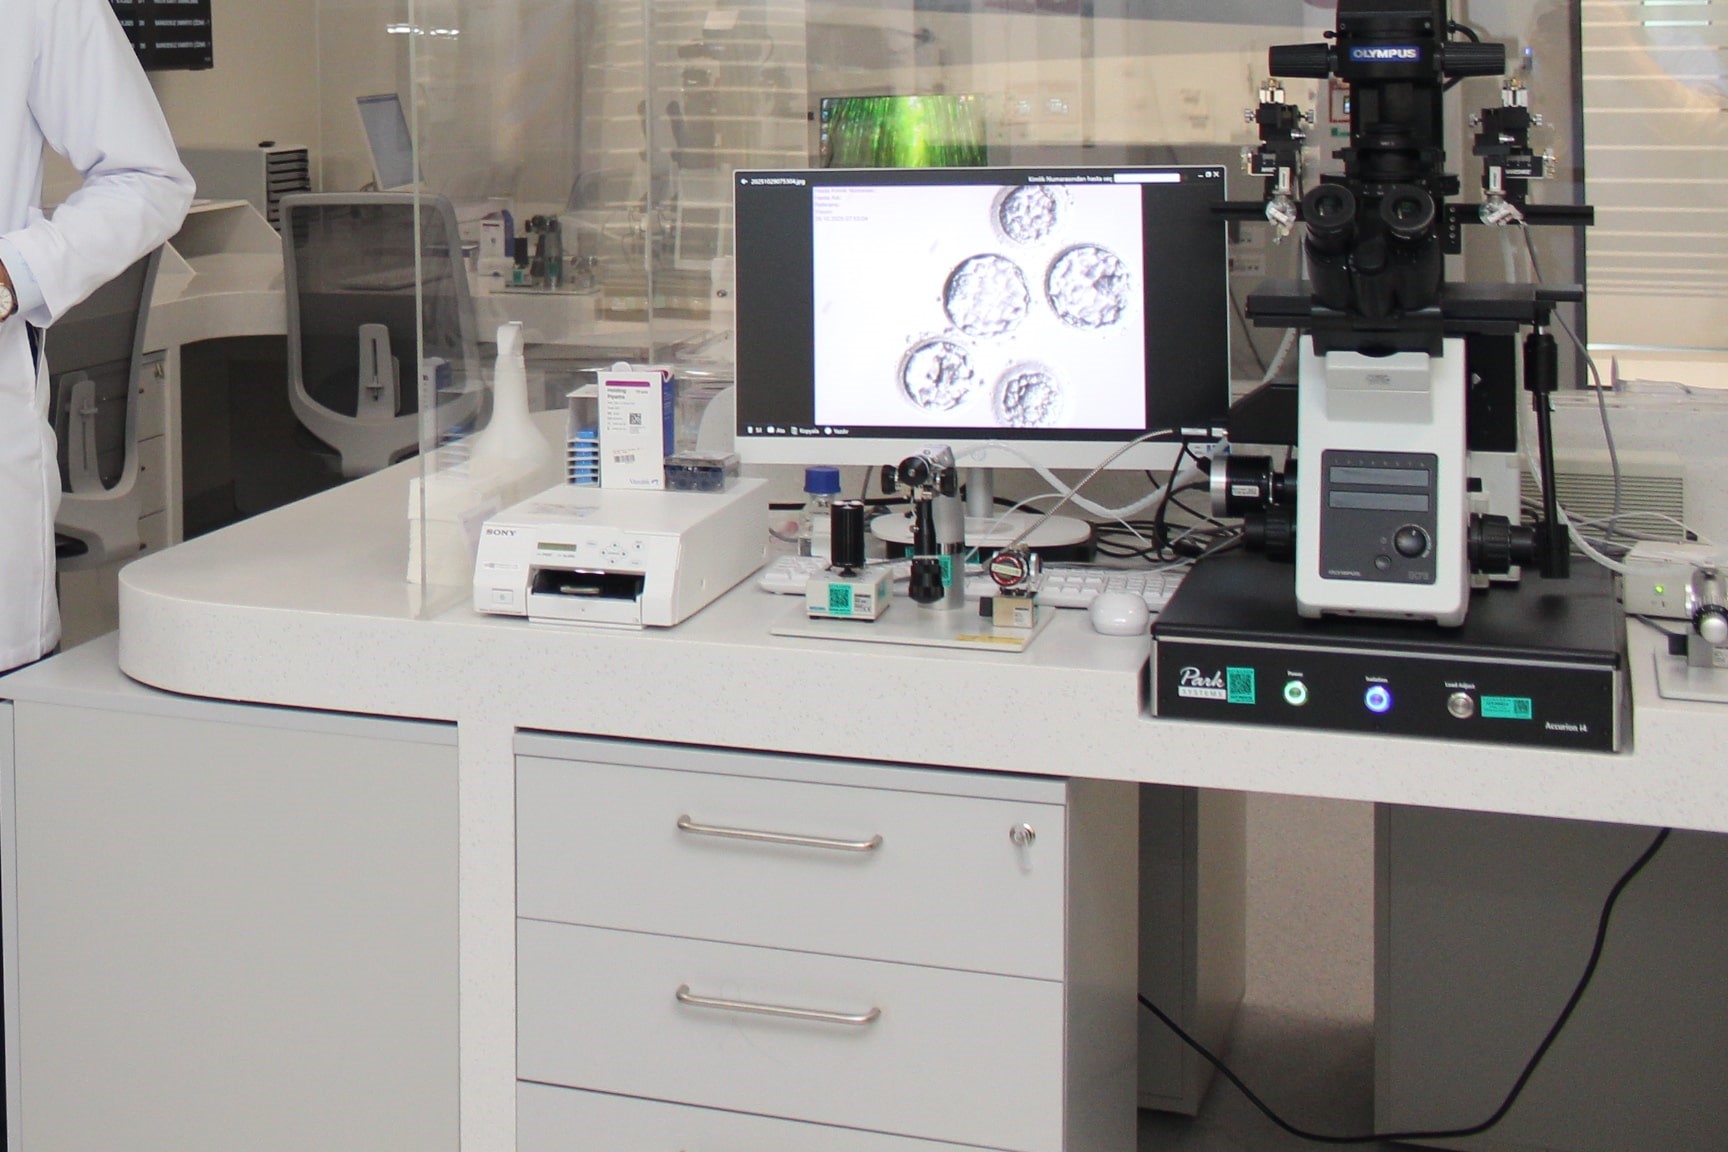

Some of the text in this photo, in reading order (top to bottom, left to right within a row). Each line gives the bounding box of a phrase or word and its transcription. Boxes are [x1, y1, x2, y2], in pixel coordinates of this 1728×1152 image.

[1352, 49, 1417, 59] OLYMPUS
[1180, 666, 1224, 688] Park
[1545, 721, 1578, 732] Accurion
